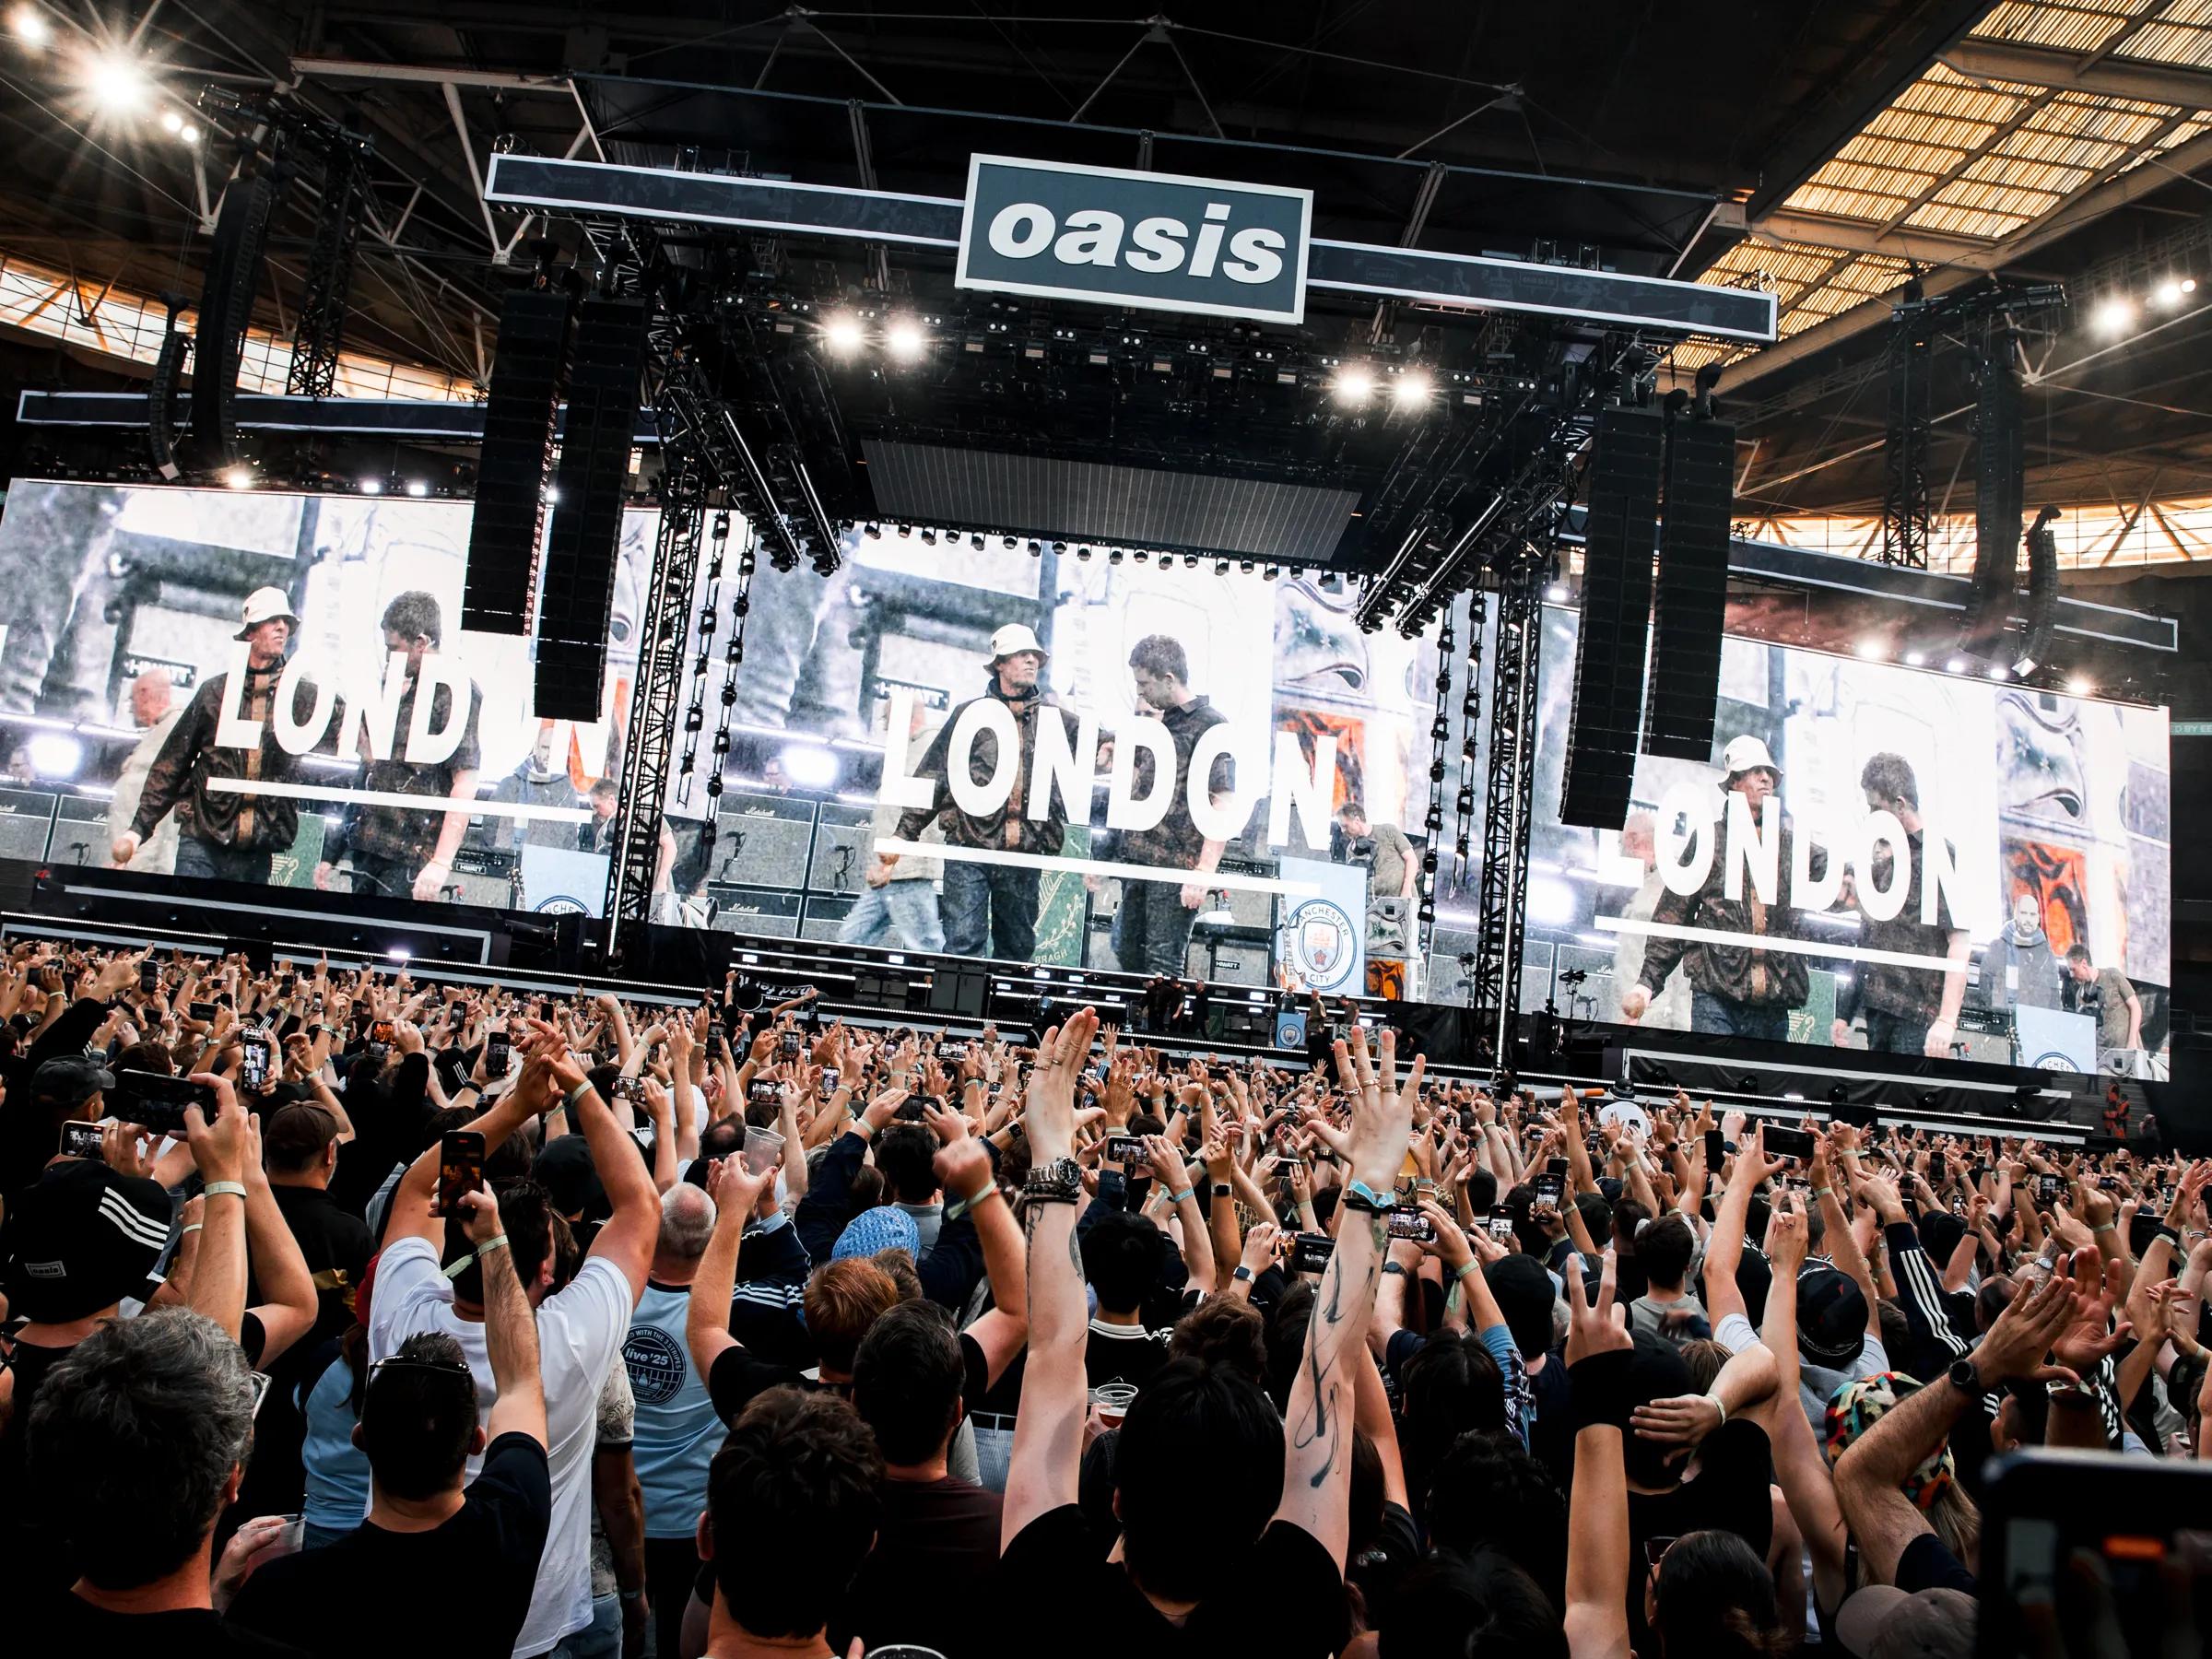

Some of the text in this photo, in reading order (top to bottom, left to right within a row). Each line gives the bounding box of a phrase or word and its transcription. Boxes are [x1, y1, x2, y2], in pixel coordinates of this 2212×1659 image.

[988, 202, 1286, 285] oasis
[214, 640, 619, 779] LONDN
[2184, 724, 2198, 733] BY
[877, 689, 1337, 852] LONDON
[745, 806, 775, 818] Marshall
[728, 902, 760, 914] Marshall
[1034, 948, 1068, 965] BRAGH
[1310, 973, 1331, 983] CITY
[32, 1266, 59, 1275] oasis
[625, 1347, 648, 1362] live
[653, 1331, 665, 1341] THE
[666, 1343, 682, 1370] STRIPES
